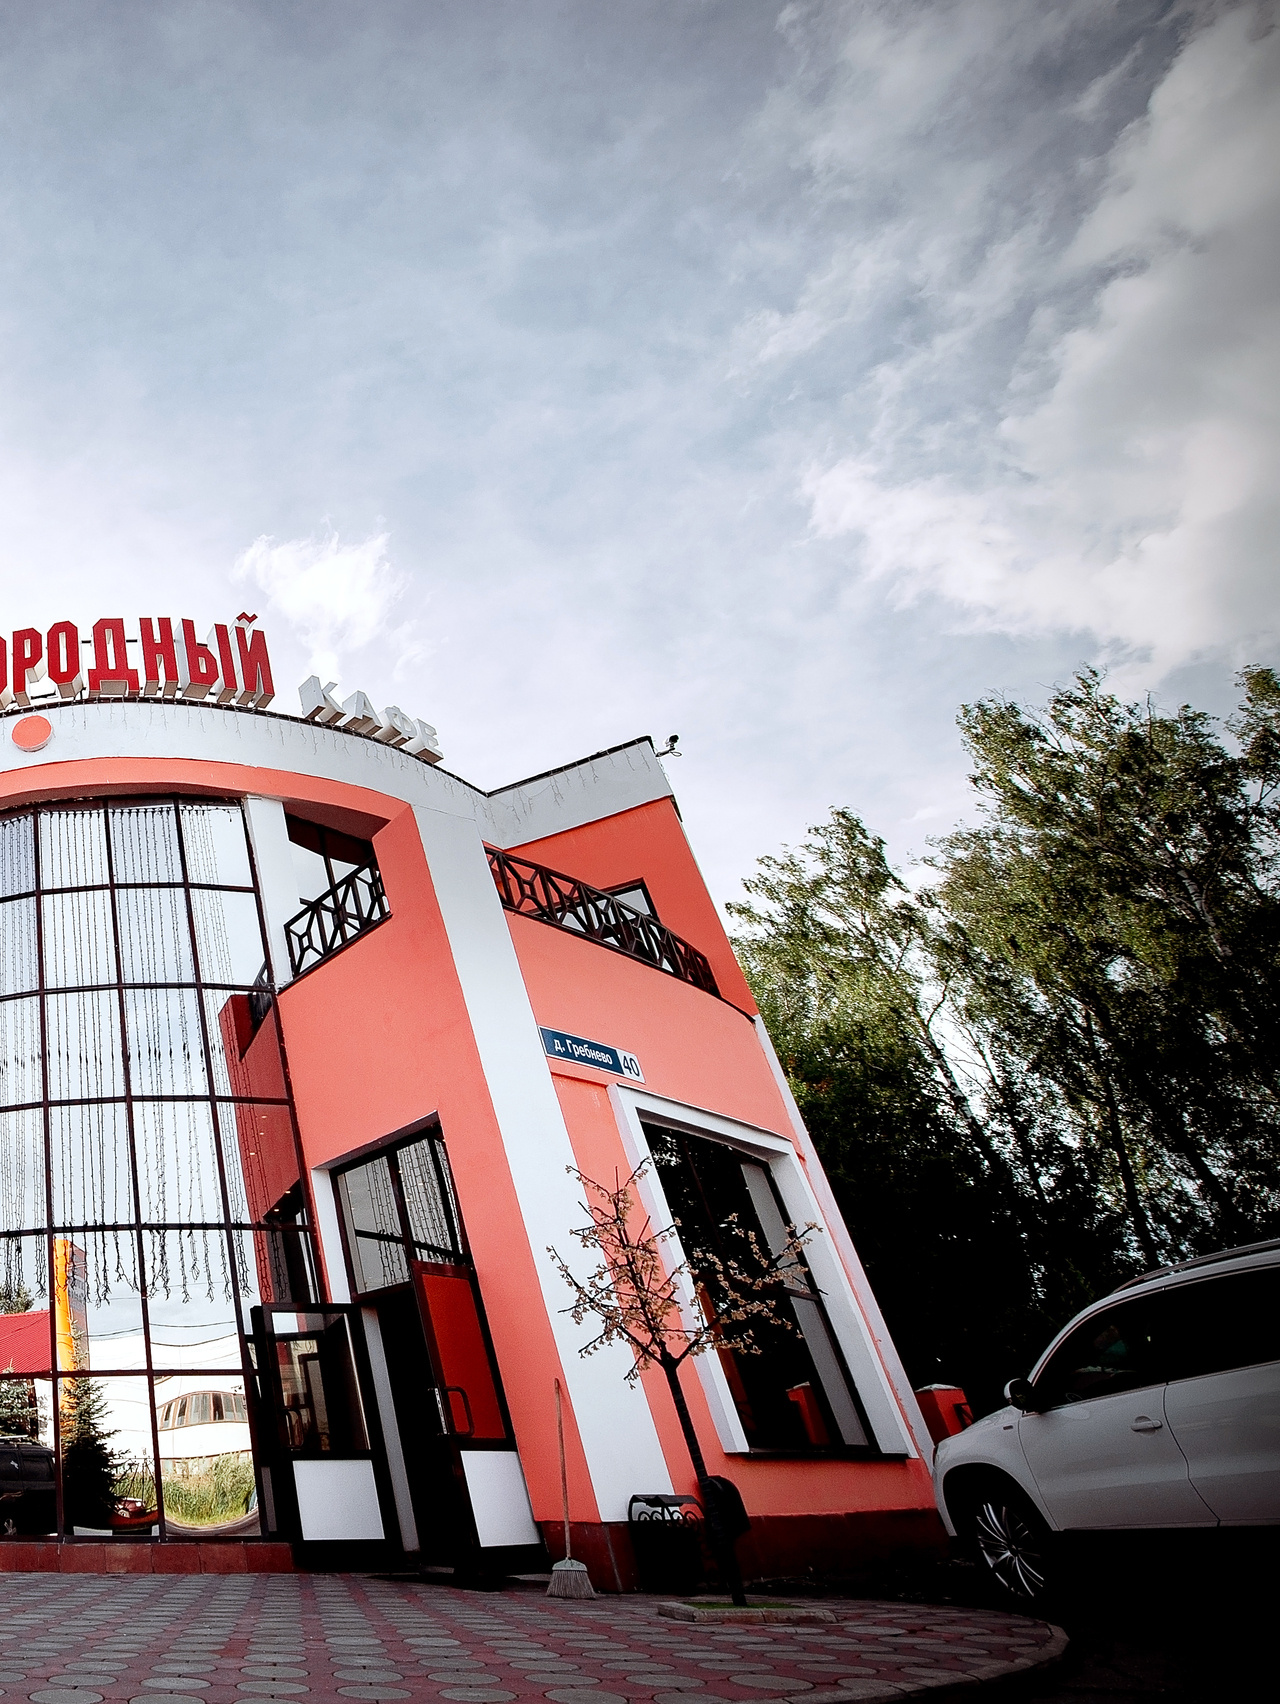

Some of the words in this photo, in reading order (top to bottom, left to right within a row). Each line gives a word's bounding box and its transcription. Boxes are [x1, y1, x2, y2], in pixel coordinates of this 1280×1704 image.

[298, 675, 444, 763] КАФЕ
[553, 1039, 566, 1053] д.
[565, 1039, 613, 1065] Гребнево
[623, 1055, 640, 1077] 40
